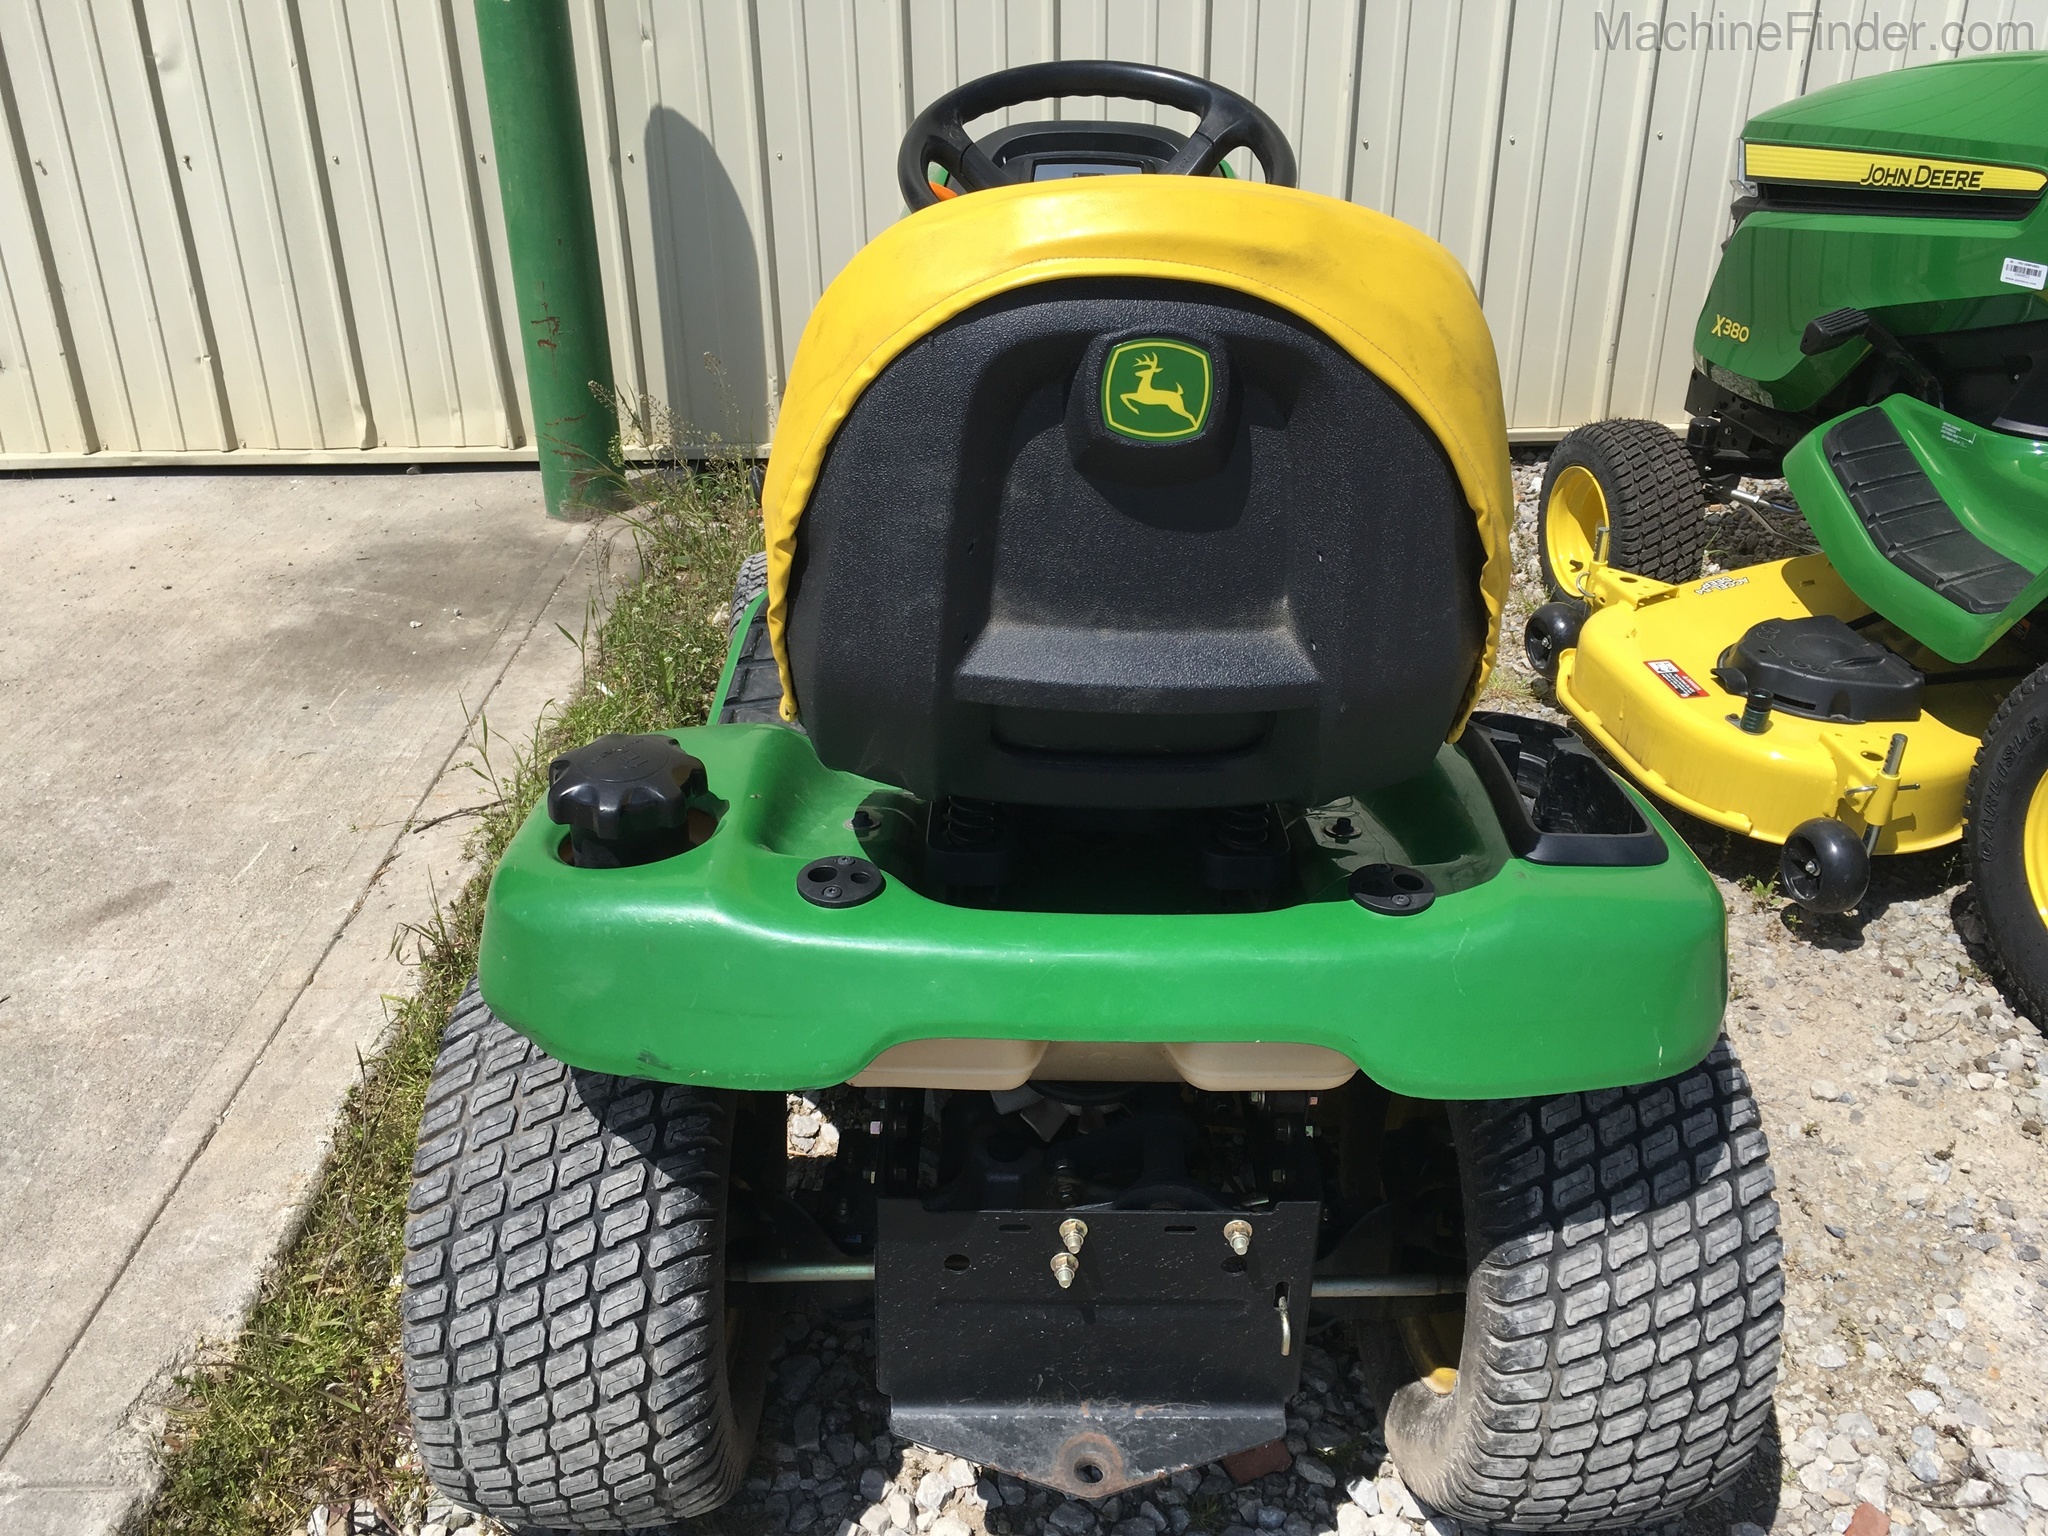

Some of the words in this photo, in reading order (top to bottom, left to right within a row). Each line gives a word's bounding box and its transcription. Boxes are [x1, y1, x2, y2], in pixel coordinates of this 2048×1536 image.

[1860, 163, 1912, 186] JOHN
[1913, 165, 1984, 191] DEERE
[1711, 313, 1750, 343] X380
